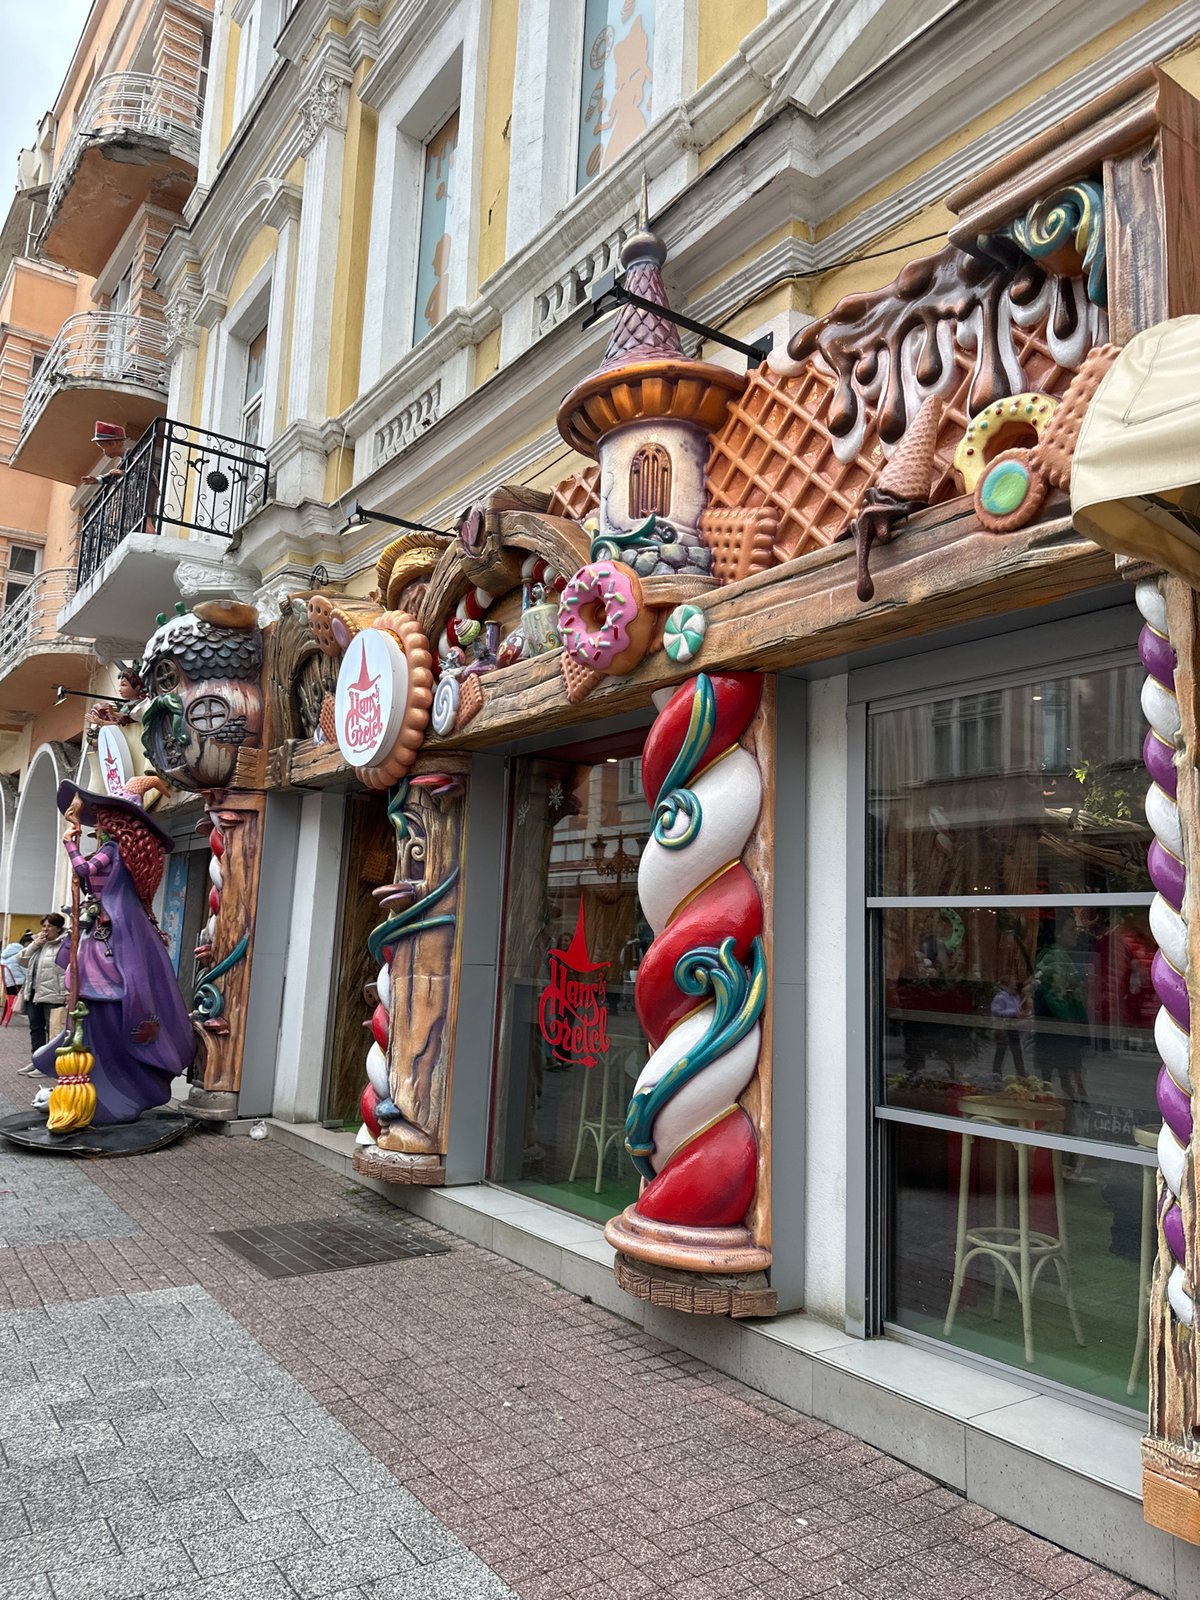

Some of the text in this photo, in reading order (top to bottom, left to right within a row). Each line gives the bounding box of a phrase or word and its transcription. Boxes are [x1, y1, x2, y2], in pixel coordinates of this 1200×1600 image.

[345, 703, 383, 748] Gretel
[349, 690, 377, 728] Hans
[549, 957, 599, 1026] Hans
[539, 1006, 611, 1054] Gretel
